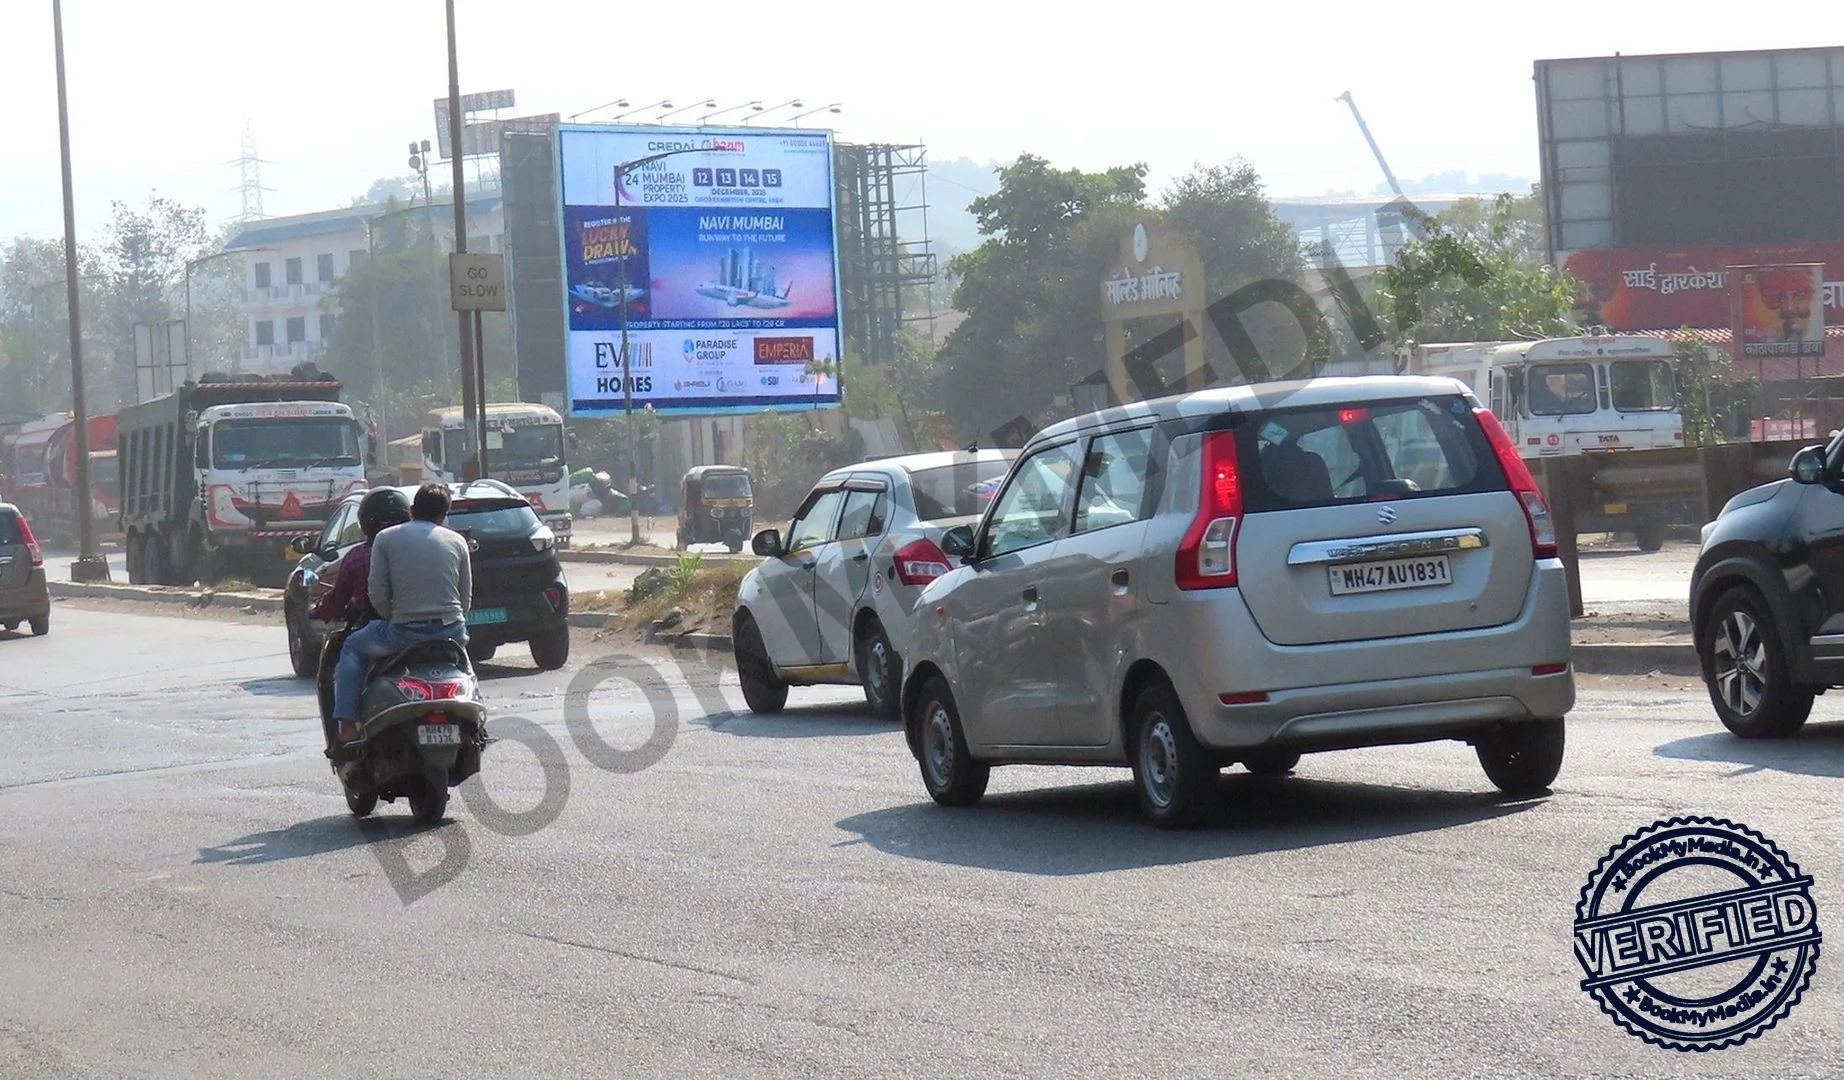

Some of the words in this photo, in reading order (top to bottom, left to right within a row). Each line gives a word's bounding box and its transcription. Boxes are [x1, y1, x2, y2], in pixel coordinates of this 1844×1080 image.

[641, 161, 667, 172] NAVI
[625, 173, 640, 186] 24
[643, 172, 686, 184] MUMBAI
[697, 172, 708, 184] 12
[720, 172, 732, 184] 13
[743, 173, 755, 184] 14
[766, 173, 777, 185] 15
[643, 184, 686, 194] PROPERTY
[644, 193, 666, 203] EXPO
[668, 193, 689, 203] 2025
[699, 216, 730, 230] NAVI
[733, 215, 784, 230] MUMBAI
[699, 233, 730, 242] RUNWAY
[732, 233, 742, 242] TO
[743, 233, 758, 242] THE
[758, 233, 786, 243] FUTURE
[467, 267, 488, 279] GO
[1623, 262, 1657, 290] साई
[459, 284, 498, 297] SLOW
[695, 340, 737, 349] PARADISE
[759, 342, 809, 359] EMPERIA
[696, 350, 726, 360] GROUP
[597, 376, 652, 393] HOMES
[767, 376, 779, 385] SBI
[1598, 435, 1620, 443] TATA
[1343, 560, 1447, 589] MH47AU1831
